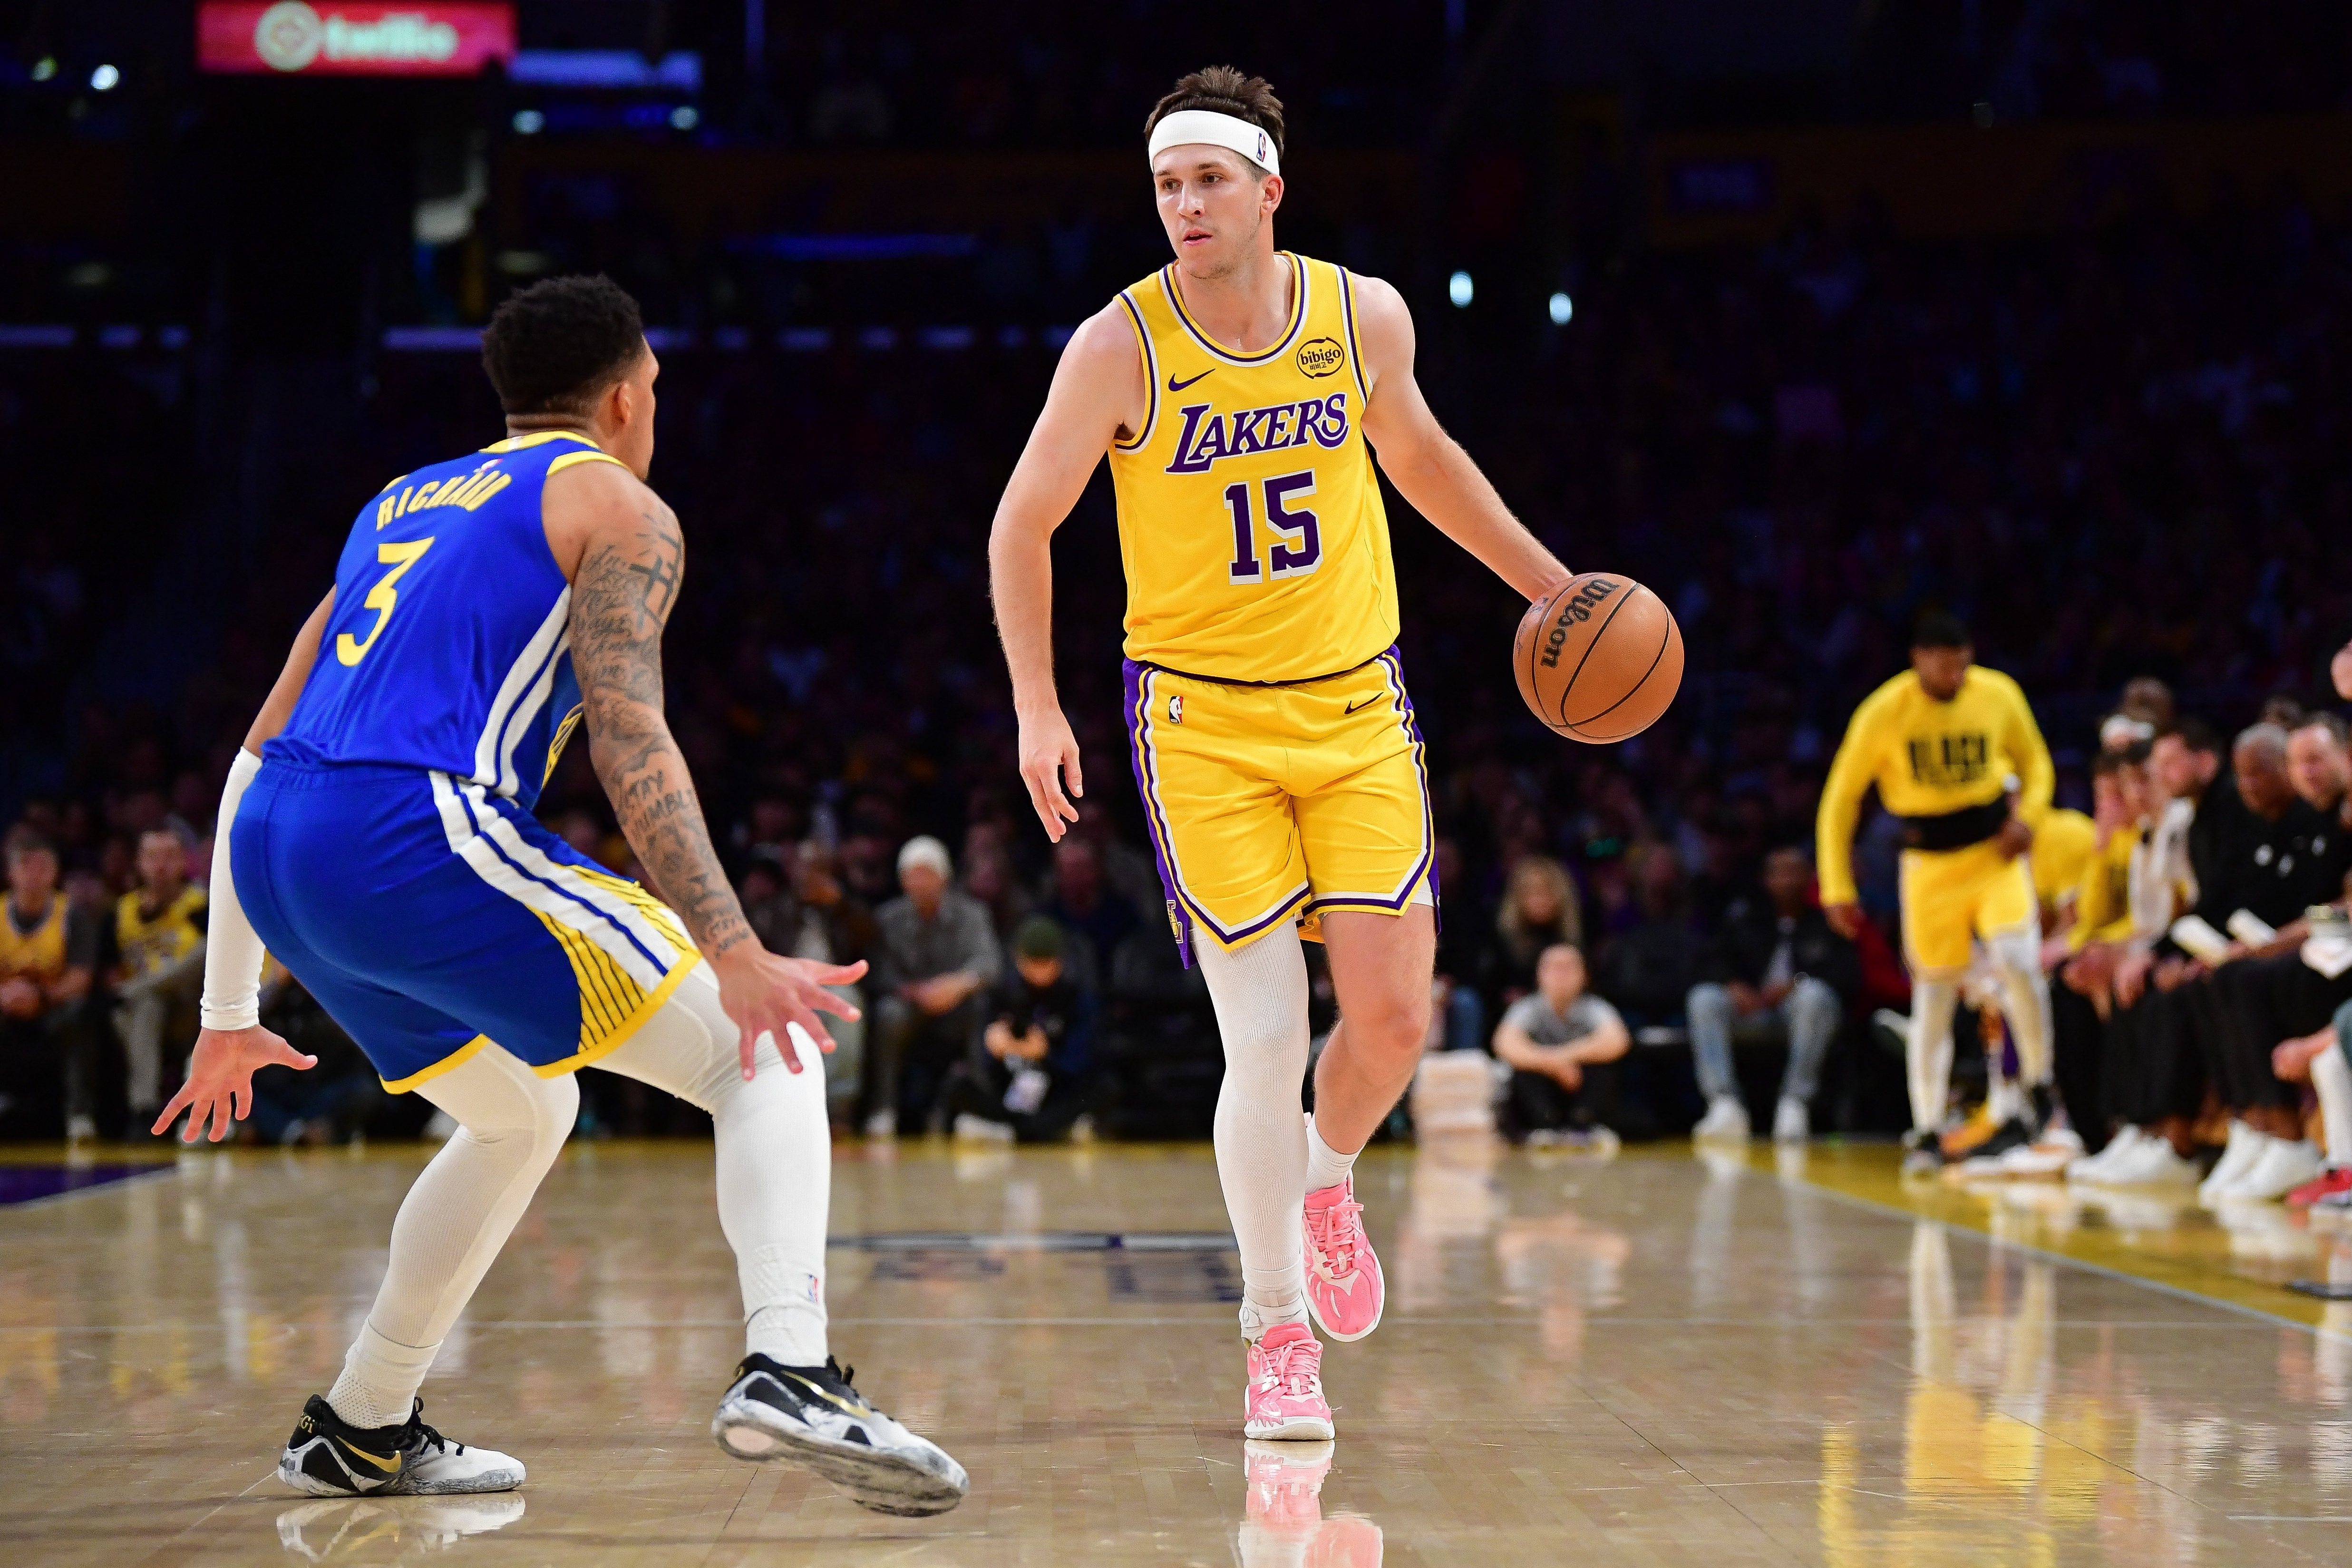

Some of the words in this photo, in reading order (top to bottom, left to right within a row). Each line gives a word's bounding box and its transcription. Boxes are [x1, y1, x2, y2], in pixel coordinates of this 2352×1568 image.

[1300, 348, 1341, 365] bibigo
[1309, 361, 1327, 370] 비비고
[1164, 392, 1350, 475] LAKERS
[1222, 467, 1324, 585] 15
[336, 536, 435, 667] 3
[1540, 578, 1622, 669] Wilson
